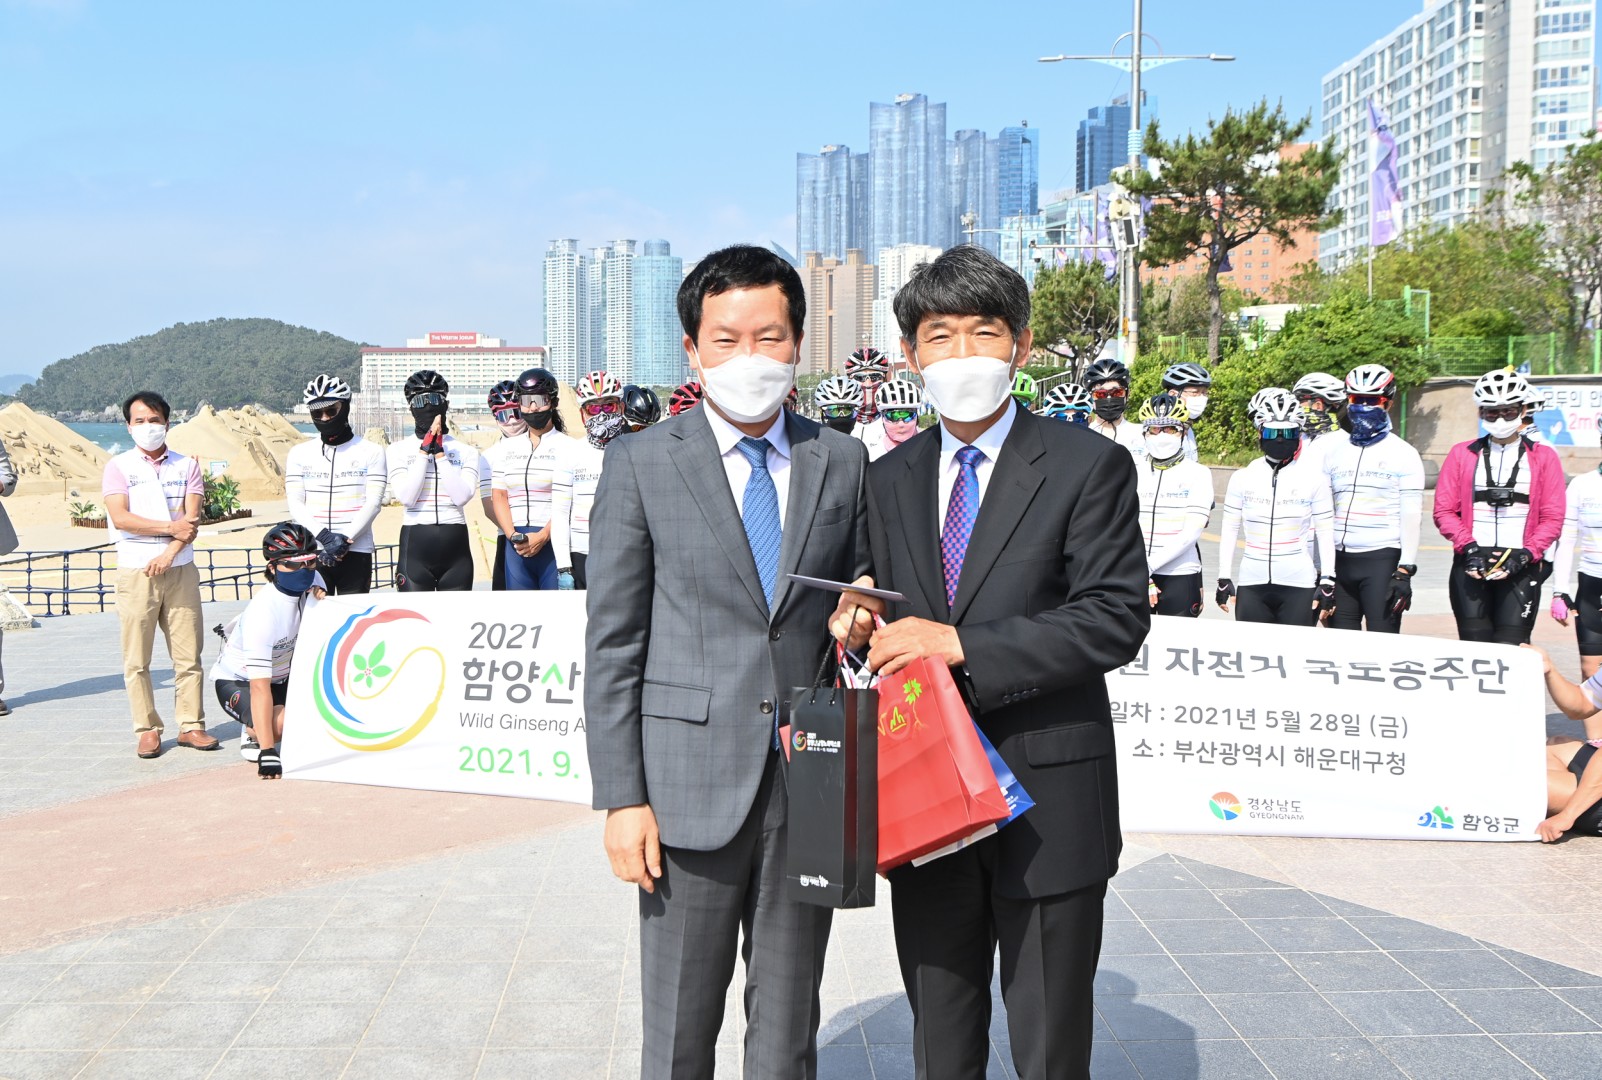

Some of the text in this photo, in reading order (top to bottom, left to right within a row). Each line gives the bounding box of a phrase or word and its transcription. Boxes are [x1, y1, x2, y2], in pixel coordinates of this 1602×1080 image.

[468, 621, 543, 650] 2021
[1165, 647, 1287, 679] 자전거
[462, 657, 582, 704] 함양산
[459, 712, 494, 729] Wild
[500, 713, 569, 736] Ginseng
[1174, 705, 1256, 730] 2021년
[1265, 710, 1301, 733] 5월
[1309, 713, 1360, 737] 28일
[1370, 714, 1408, 739] (금)
[459, 746, 580, 779] 2021. 9.
[1132, 738, 1154, 758] 소
[1173, 740, 1284, 767] 부산광역시
[1294, 746, 1406, 775] 해운대구청
[1247, 797, 1303, 813] 경상남도
[1249, 811, 1305, 821] GYEONGNAM
[1462, 813, 1520, 834] 함양군
